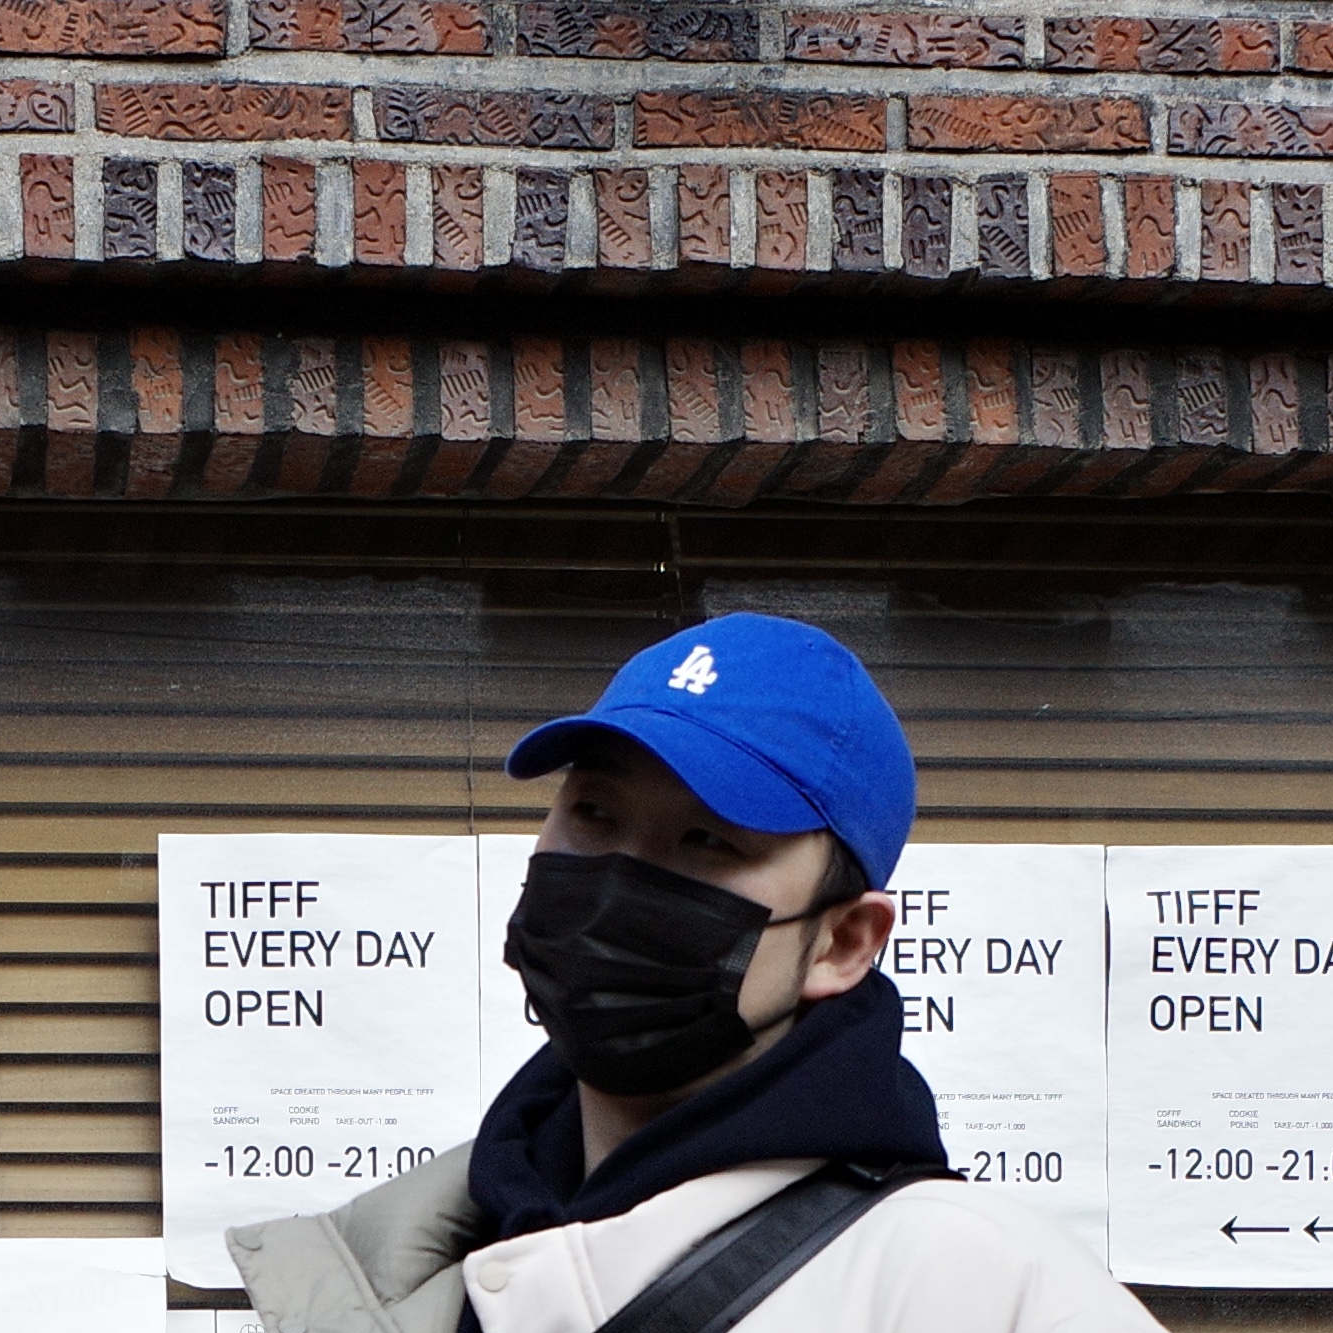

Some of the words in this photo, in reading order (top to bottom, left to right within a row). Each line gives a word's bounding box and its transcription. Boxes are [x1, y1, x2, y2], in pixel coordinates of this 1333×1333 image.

[668, 645, 718, 694] LA
[205, 931, 340, 967] EVERY
[357, 931, 435, 967] DAY
[873, 938, 971, 974] VERY
[987, 938, 1063, 975] DAY
[1152, 936, 1280, 974] EVERY
[206, 990, 322, 1026] OPEN
[902, 996, 954, 1032] EN
[1151, 995, 1262, 1032] OPEN
[212, 1116, 260, 1125] SANDWICH
[1156, 1119, 1202, 1128] SANDWICH
[205, 1146, 313, 1177] -12:00
[958, 1151, 1062, 1182] -21:00
[1149, 1149, 1252, 1180] -12:00
